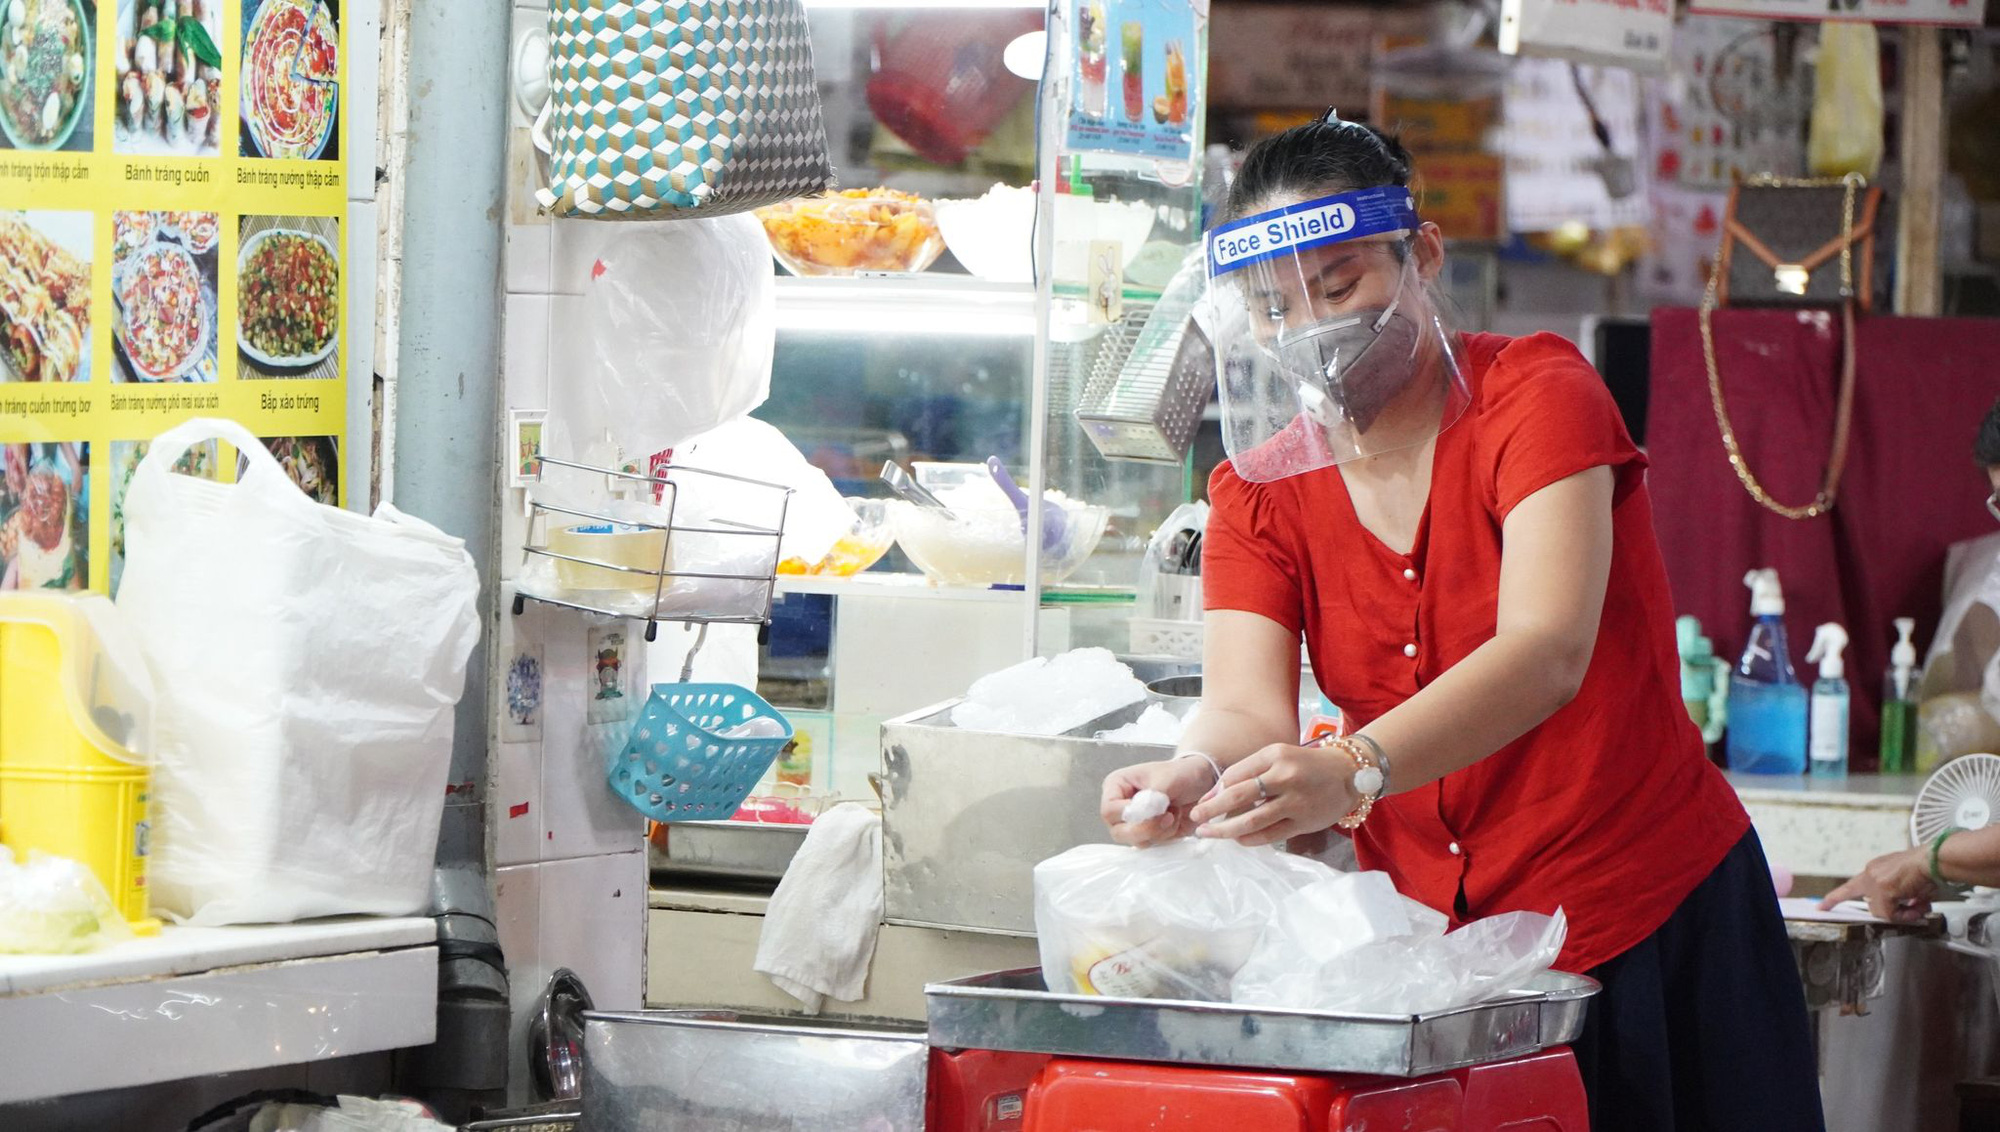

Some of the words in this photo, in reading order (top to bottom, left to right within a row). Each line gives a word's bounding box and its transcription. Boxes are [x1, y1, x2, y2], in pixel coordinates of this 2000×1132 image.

[125, 163, 152, 181] Bánh
[155, 164, 181, 186] tráng
[184, 162, 209, 182] cuốn
[237, 167, 257, 184] Bánh
[1217, 235, 1260, 260] Face
[1266, 207, 1345, 245] Shield
[4, 396, 27, 418] tráng
[29, 393, 50, 414] cuốn
[53, 396, 77, 417] trứng
[79, 396, 91, 413] bơ
[296, 393, 319, 413] trứng
